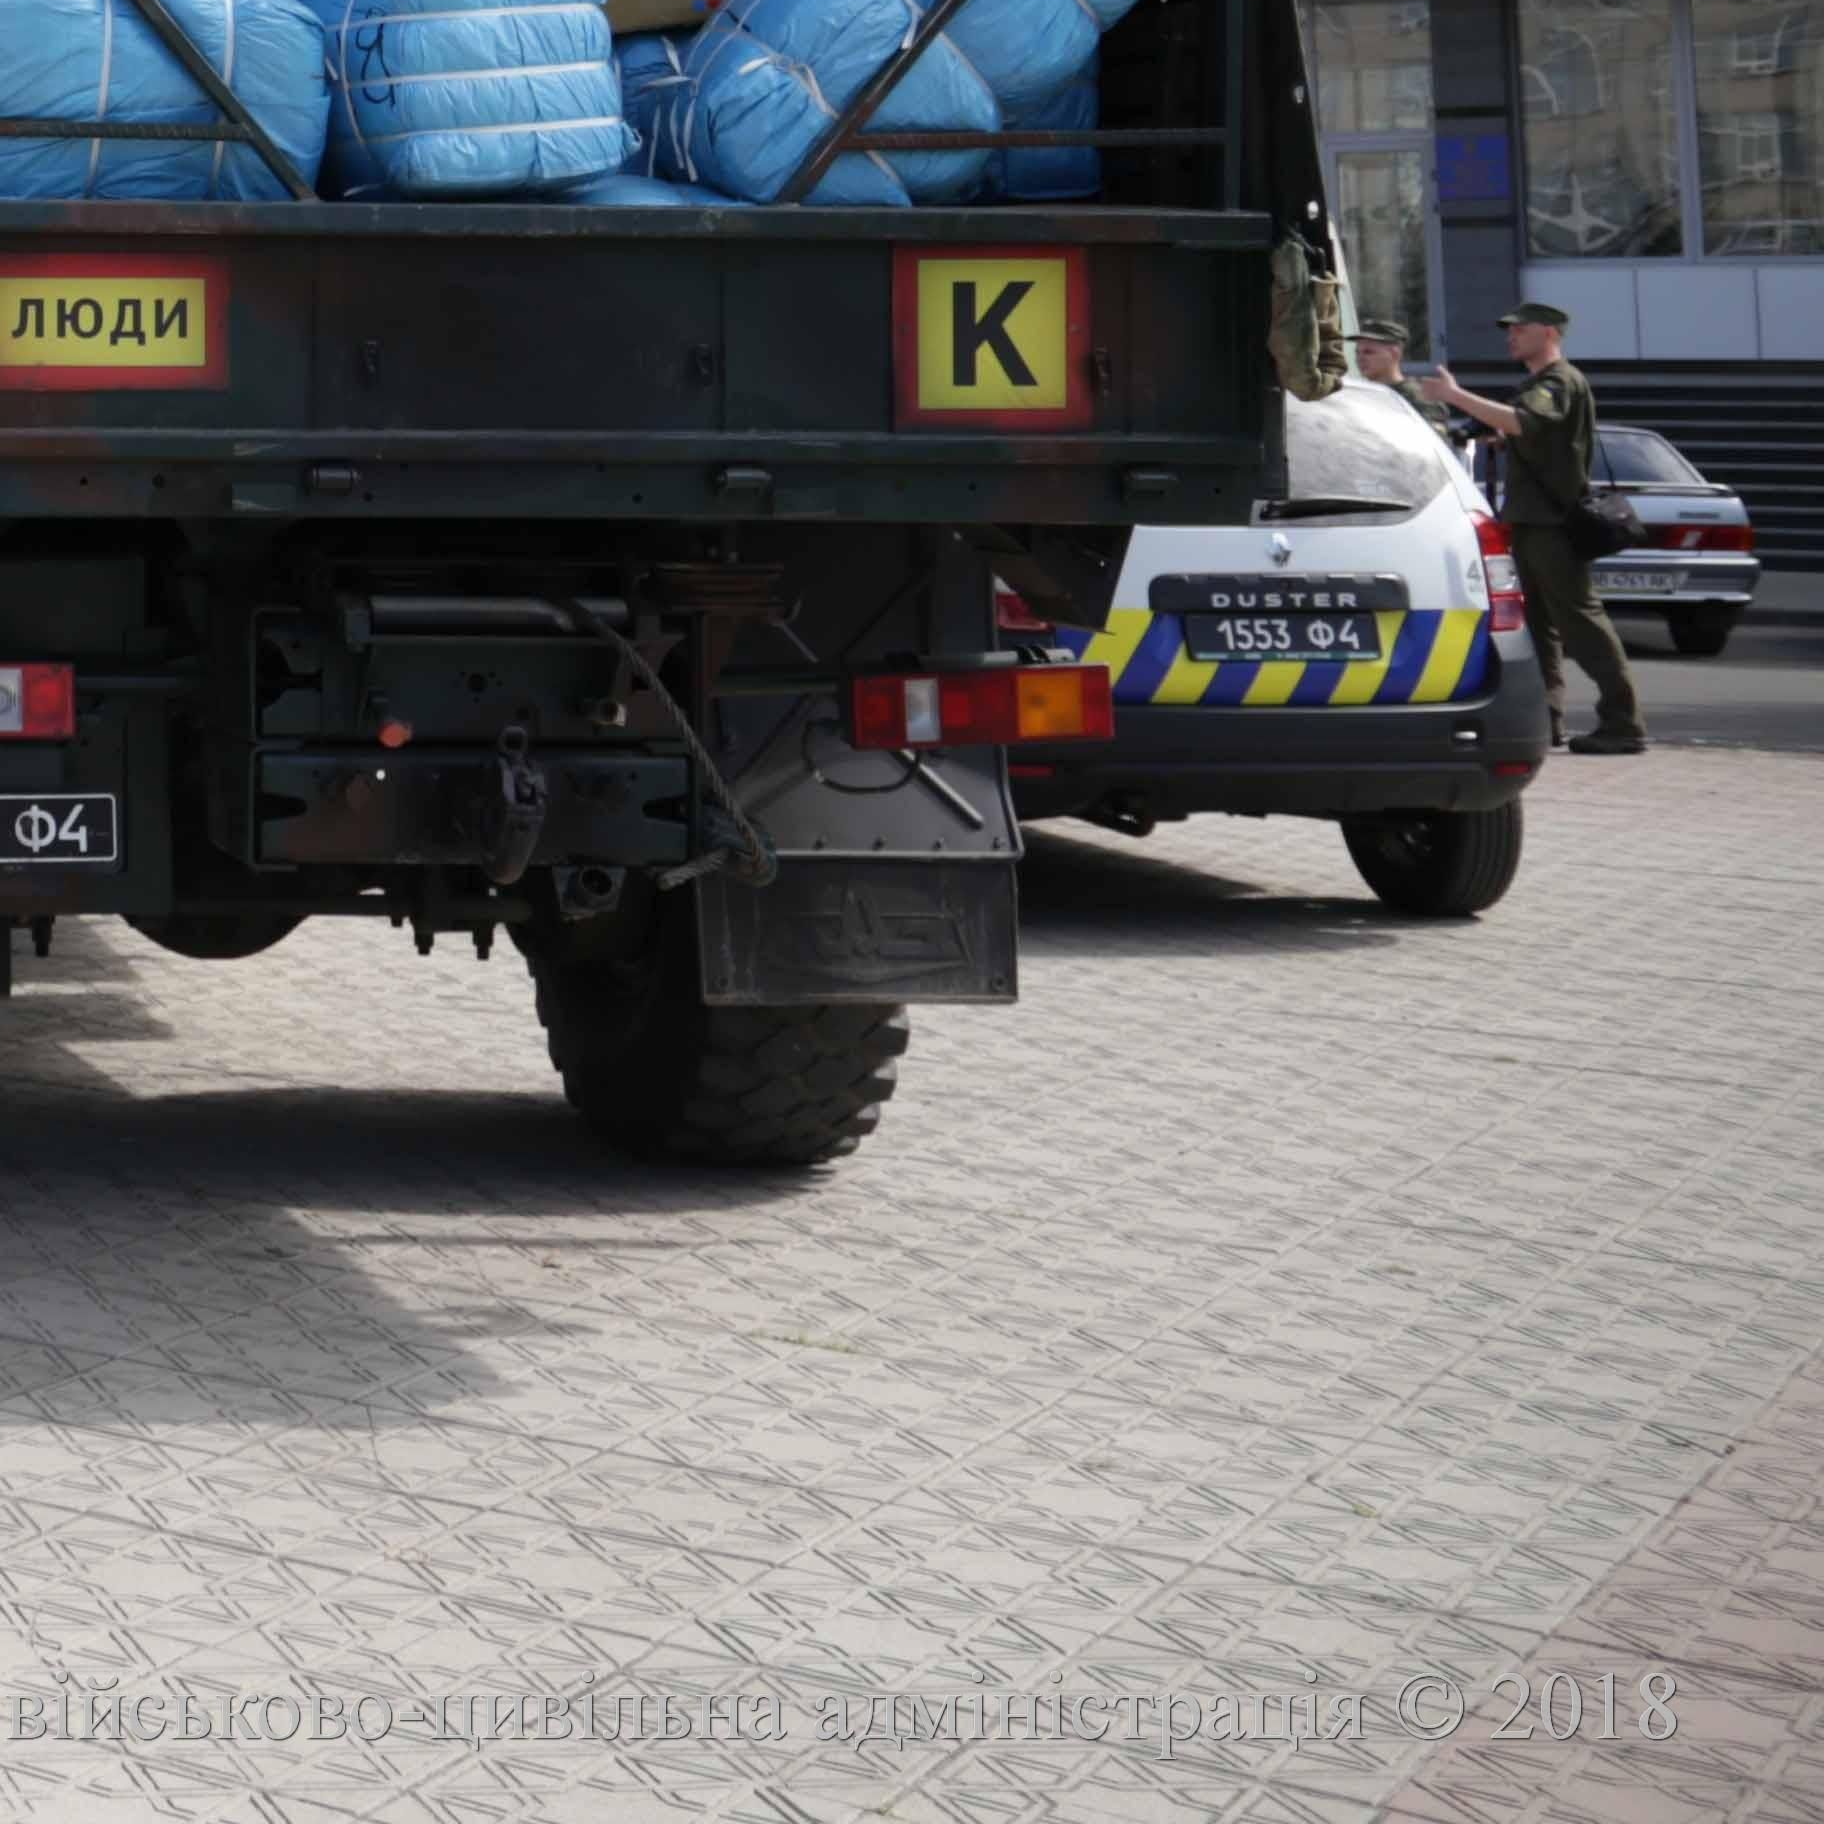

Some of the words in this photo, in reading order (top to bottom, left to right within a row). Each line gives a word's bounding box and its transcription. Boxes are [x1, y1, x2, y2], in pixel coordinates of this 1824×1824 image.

[11, 297, 190, 346] ЛЮДИ
[1211, 592, 1359, 608] DUSTER
[1216, 617, 1292, 651] 1553
[1306, 617, 1361, 651] Ф4
[14, 803, 90, 854] Ф4
